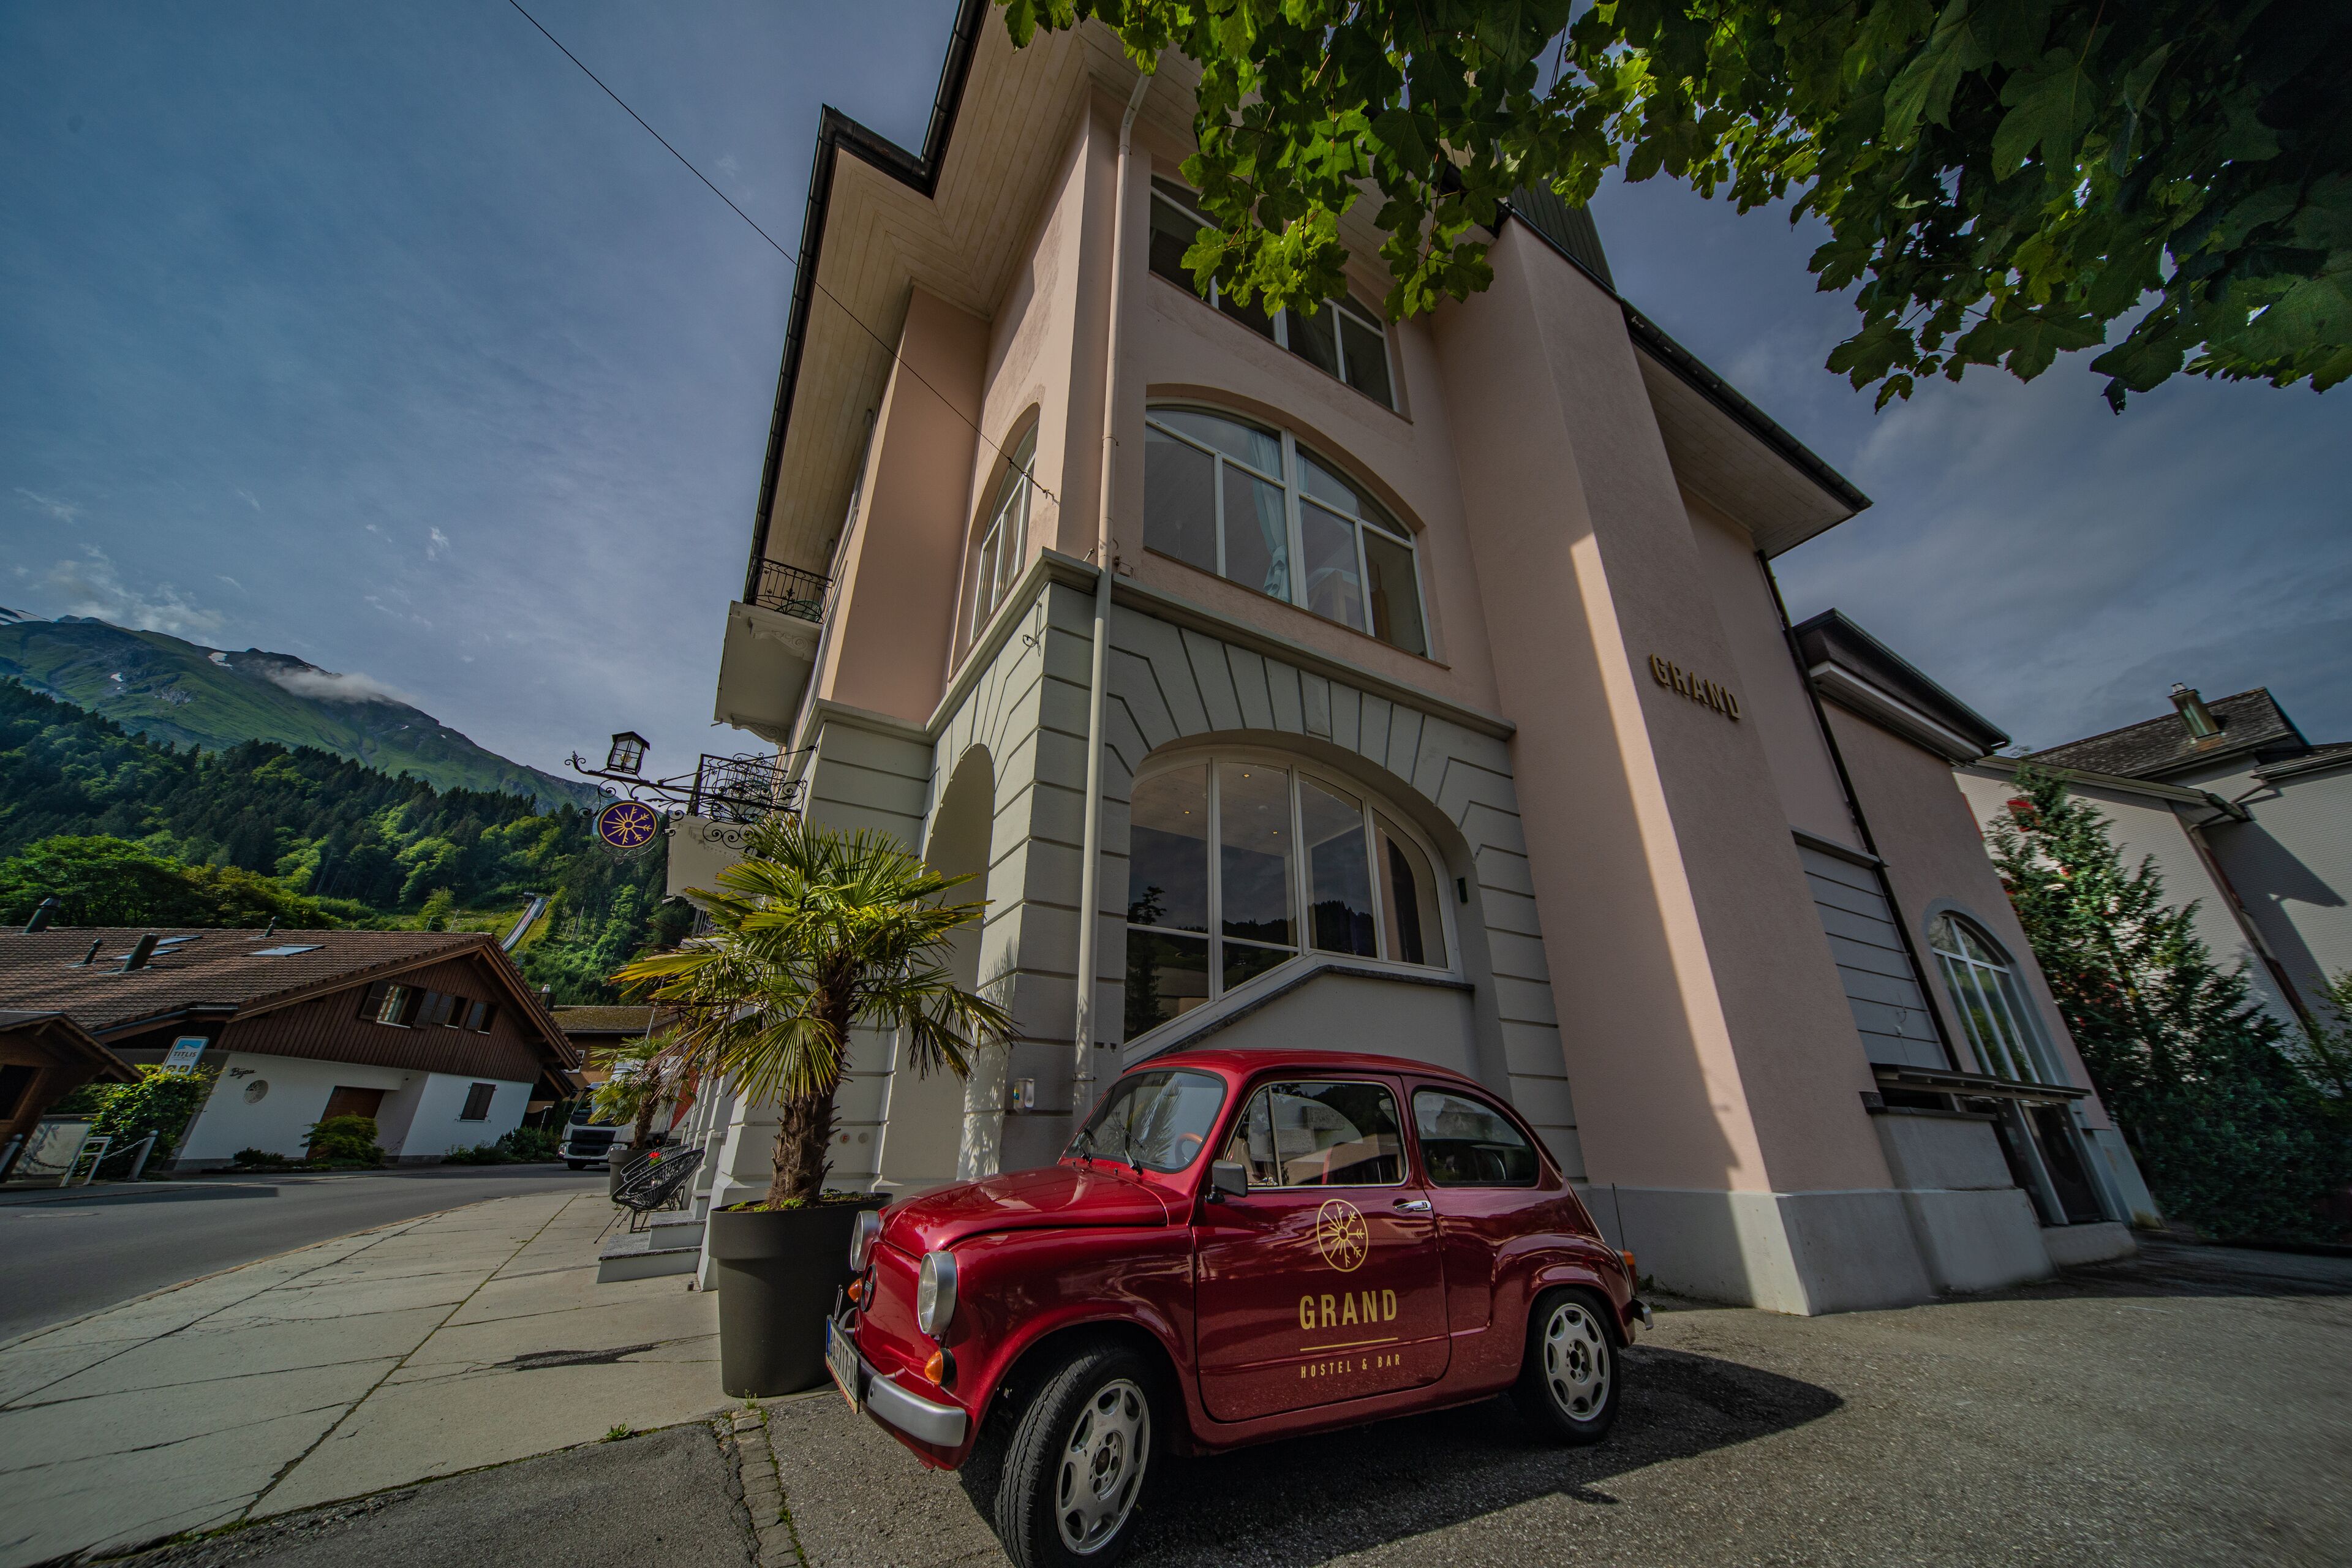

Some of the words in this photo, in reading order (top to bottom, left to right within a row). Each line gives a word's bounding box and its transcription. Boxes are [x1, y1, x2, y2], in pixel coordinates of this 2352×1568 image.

[1650, 653, 1741, 720] GRAND
[1300, 1289, 1397, 1330] GRAND
[1300, 1360, 1351, 1378] HOSTEL
[1362, 1358, 1368, 1370] &
[1378, 1354, 1400, 1367] BAR
